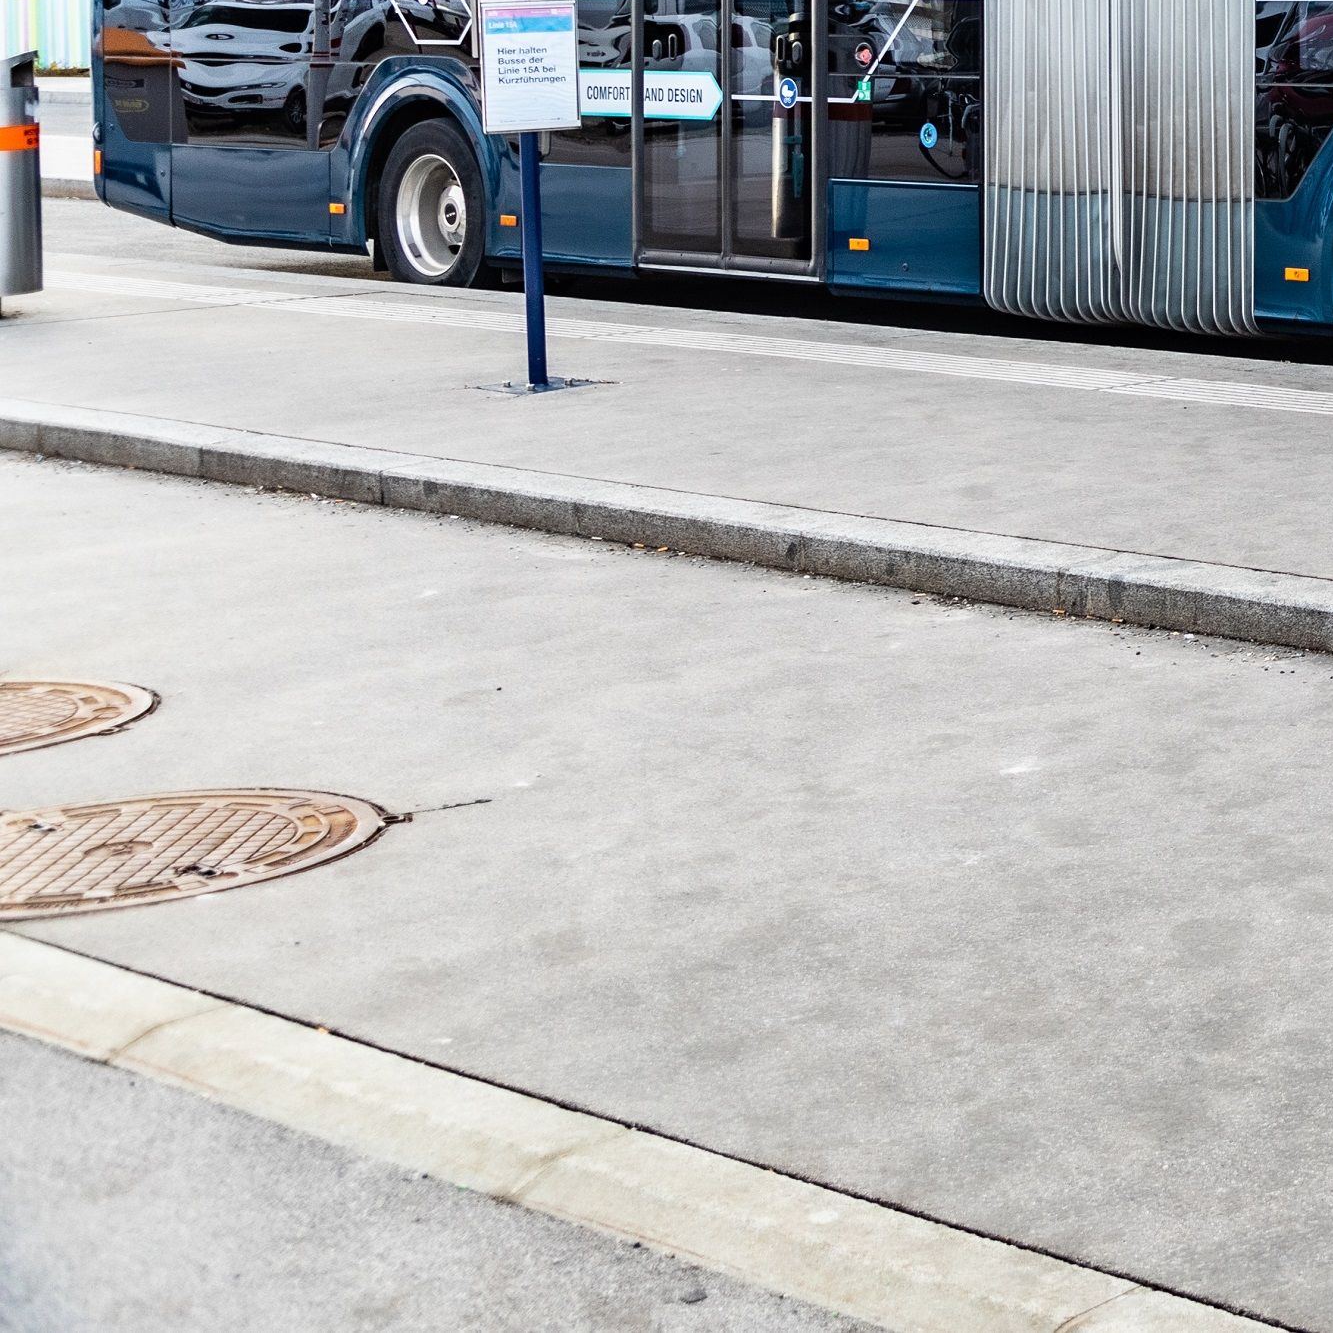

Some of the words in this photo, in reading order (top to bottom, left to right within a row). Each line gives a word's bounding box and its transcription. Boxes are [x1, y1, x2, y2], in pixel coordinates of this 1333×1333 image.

[498, 57, 526, 65] Busse
[523, 66, 540, 74] 15A
[498, 75, 567, 84] Kurzführungen
[587, 85, 631, 101] COMFORT
[644, 88, 664, 102] AND
[667, 88, 703, 103] DESIGN
